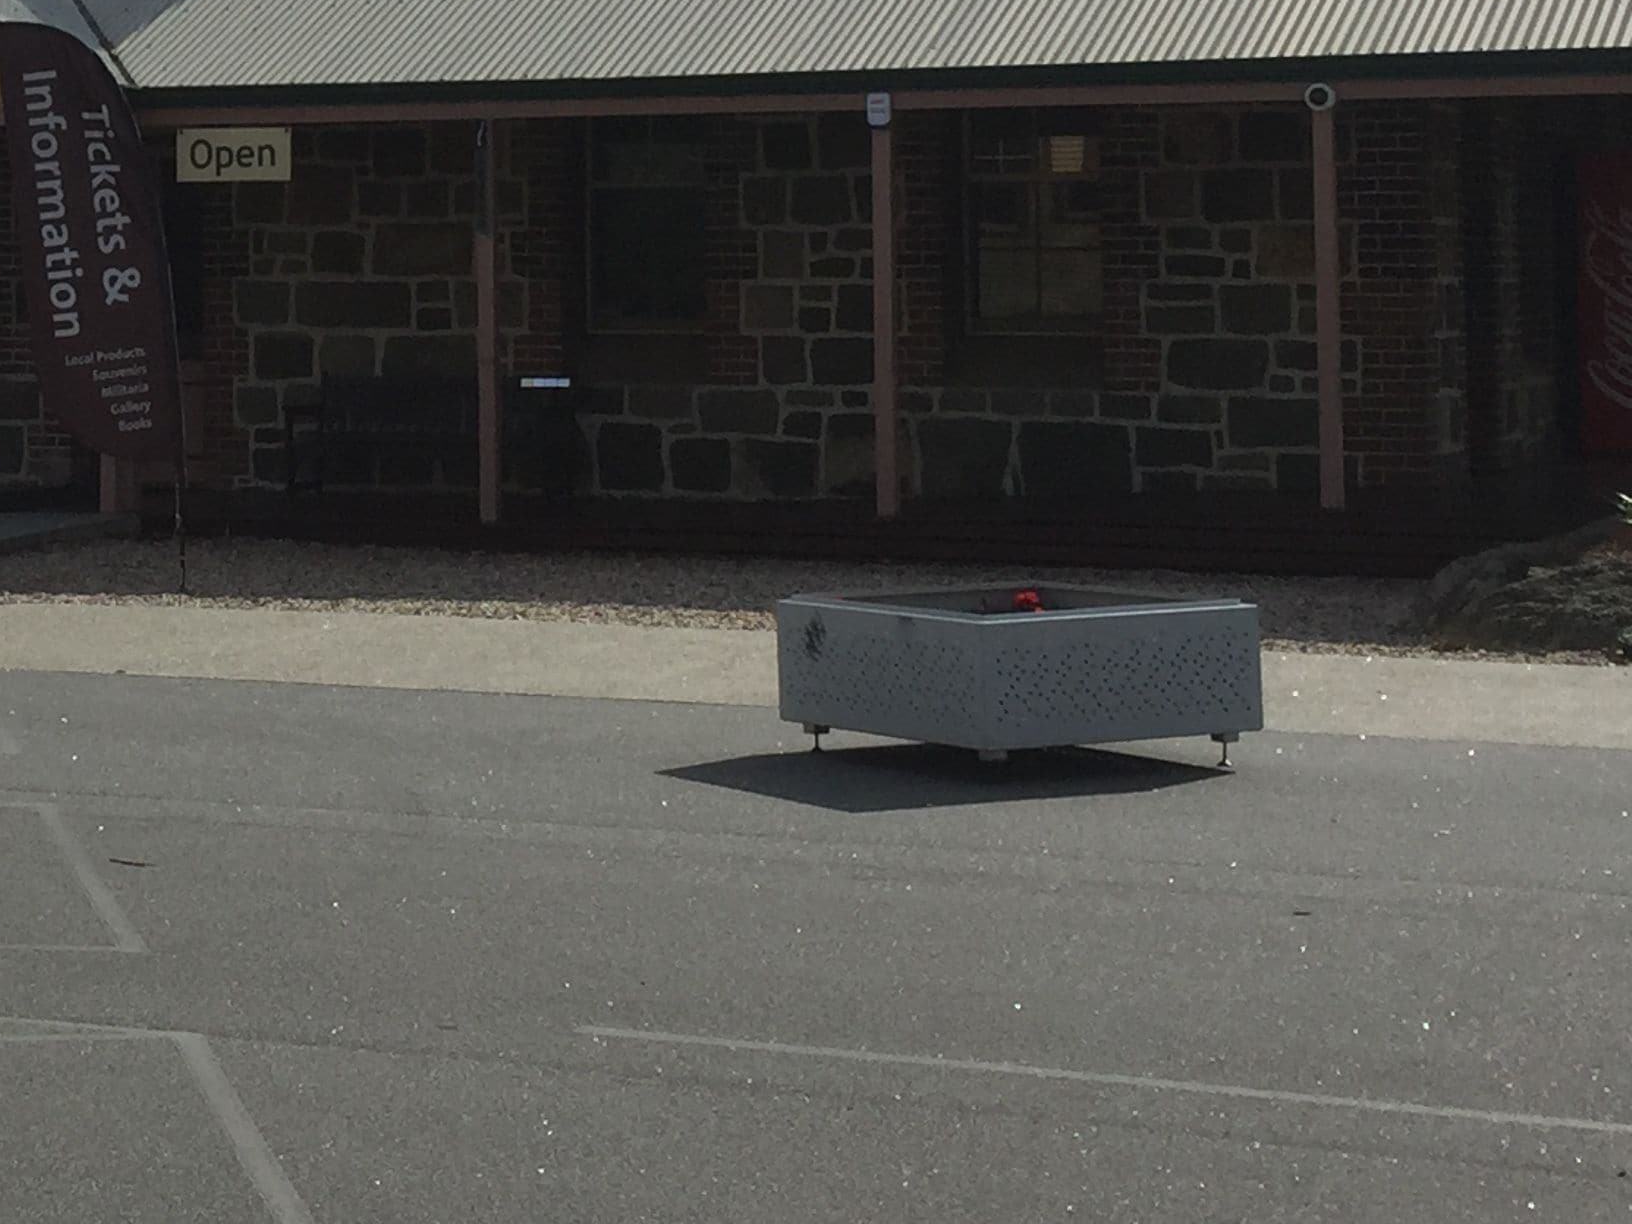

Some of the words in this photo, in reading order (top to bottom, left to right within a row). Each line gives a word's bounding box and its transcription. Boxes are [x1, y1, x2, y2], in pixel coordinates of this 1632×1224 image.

[190, 138, 277, 177] Open
[81, 103, 132, 256] Tickets
[22, 69, 84, 339] Information
[101, 266, 142, 306] &
[65, 351, 95, 367] Local
[96, 346, 147, 363] Products
[110, 400, 152, 416] Gallery
